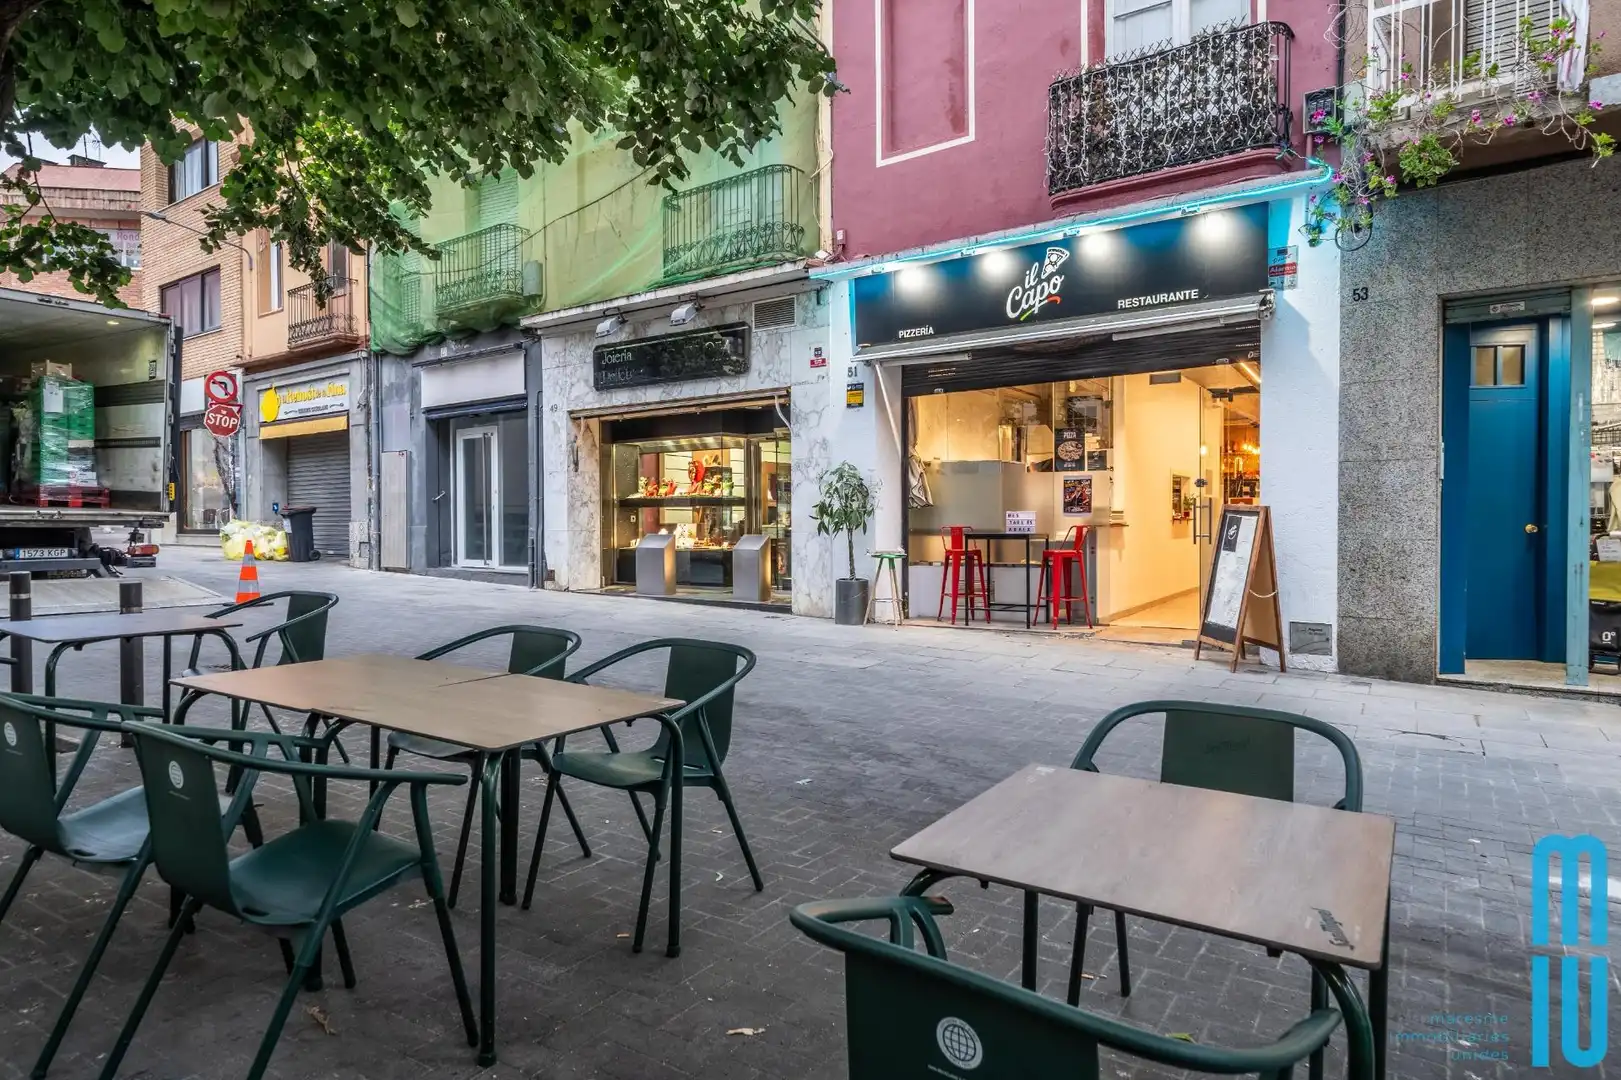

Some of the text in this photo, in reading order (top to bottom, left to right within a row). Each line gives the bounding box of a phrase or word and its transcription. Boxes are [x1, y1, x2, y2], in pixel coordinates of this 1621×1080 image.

[1025, 262, 1039, 289] il
[1006, 275, 1065, 319] Capo
[1117, 289, 1199, 309] RESTAURANTE
[1352, 287, 1369, 302] 53
[898, 325, 935, 339] PIZZERÍA
[847, 367, 858, 378] 51
[207, 413, 238, 429] STOP
[23, 549, 66, 557] 1573 KGP
